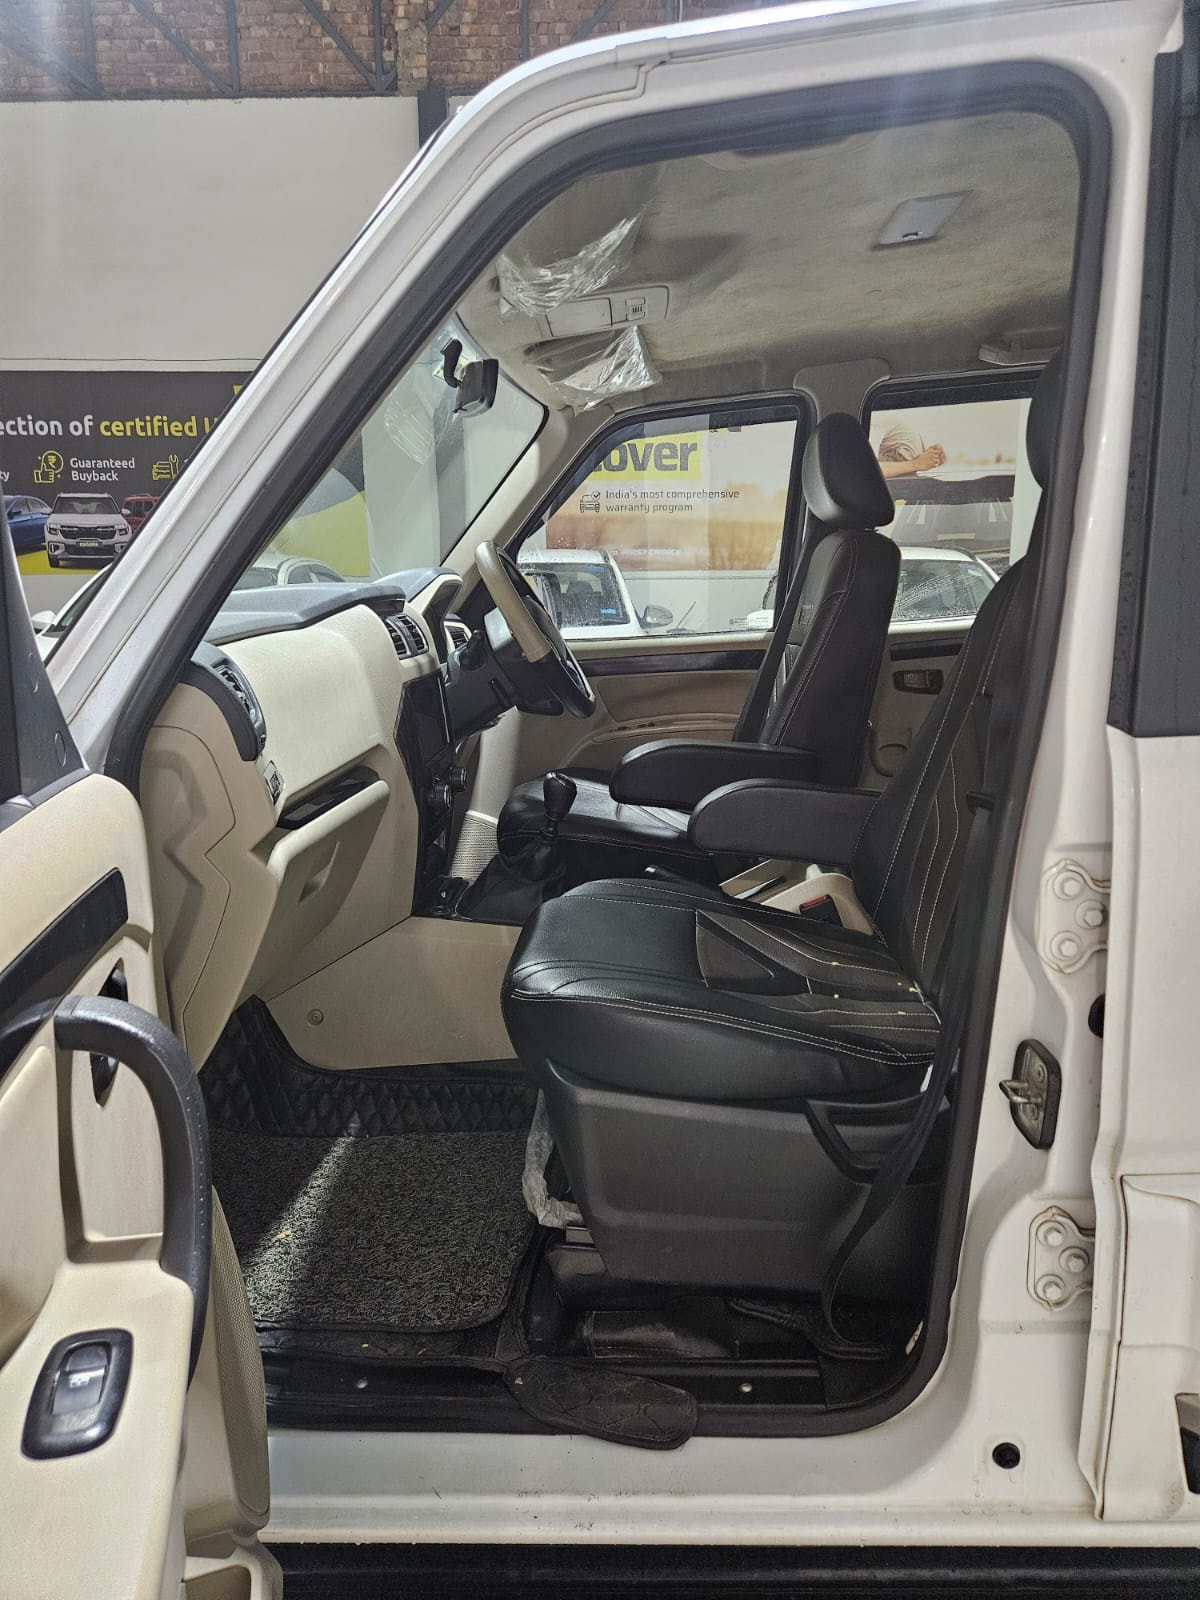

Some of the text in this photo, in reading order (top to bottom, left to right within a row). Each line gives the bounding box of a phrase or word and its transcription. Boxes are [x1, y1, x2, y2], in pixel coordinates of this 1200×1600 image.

[69, 414, 94, 436] of
[100, 415, 198, 437] certified
[70, 457, 136, 469] Guaranteed
[593, 442, 698, 472] over
[71, 470, 119, 483] Buyback
[605, 489, 740, 500] India's most comprehensive
[606, 503, 693, 513] warranty program
